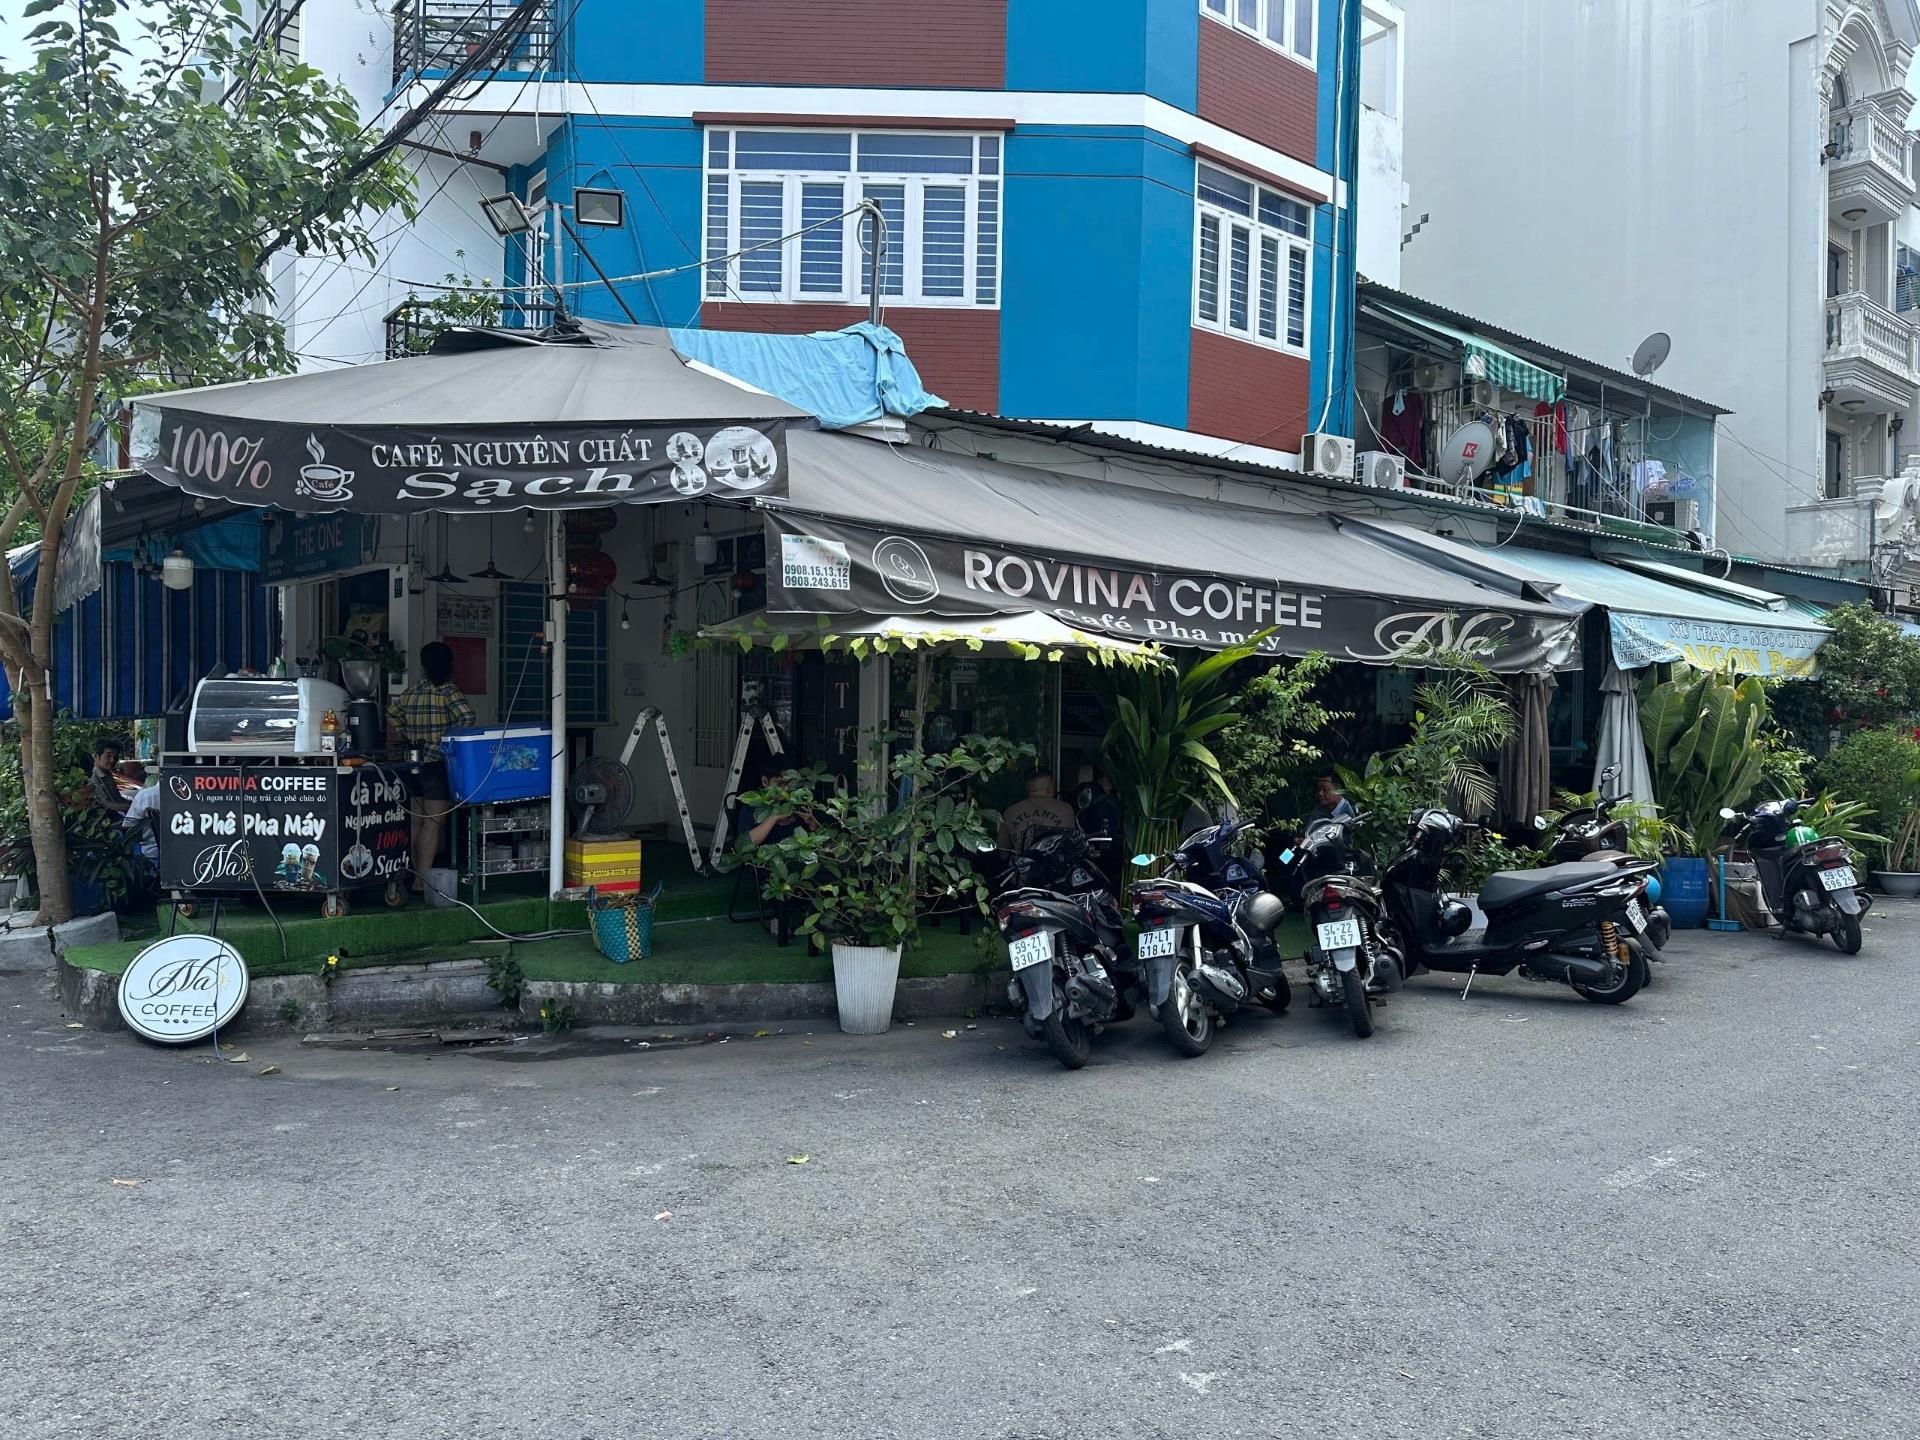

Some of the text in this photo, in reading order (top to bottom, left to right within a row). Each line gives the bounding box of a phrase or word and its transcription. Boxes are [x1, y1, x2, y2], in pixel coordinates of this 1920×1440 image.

[163, 425, 272, 489] 100%
[371, 428, 653, 468] CAFÉ NGUYÊN CHẤT
[311, 478, 335, 490] Café
[396, 467, 635, 505] Sạch
[784, 564, 848, 578] 0908.15.13.12
[784, 575, 848, 589] 0908.243.615
[963, 549, 1323, 629] ROVINA COFFEE
[1053, 608, 1133, 632] Café
[1145, 618, 1210, 642] Pha
[1693, 624, 1740, 644] TRANG
[194, 776, 327, 791] ROVINA COFFEE
[350, 778, 401, 806] Cà Phê
[235, 793, 257, 803] nững
[170, 810, 326, 841] Cà Phê Pha Máy
[344, 810, 382, 830] Nguyên
[376, 831, 408, 849] 100%
[1143, 930, 1168, 945] 77-L1
[141, 1003, 216, 1017] COFFEE
